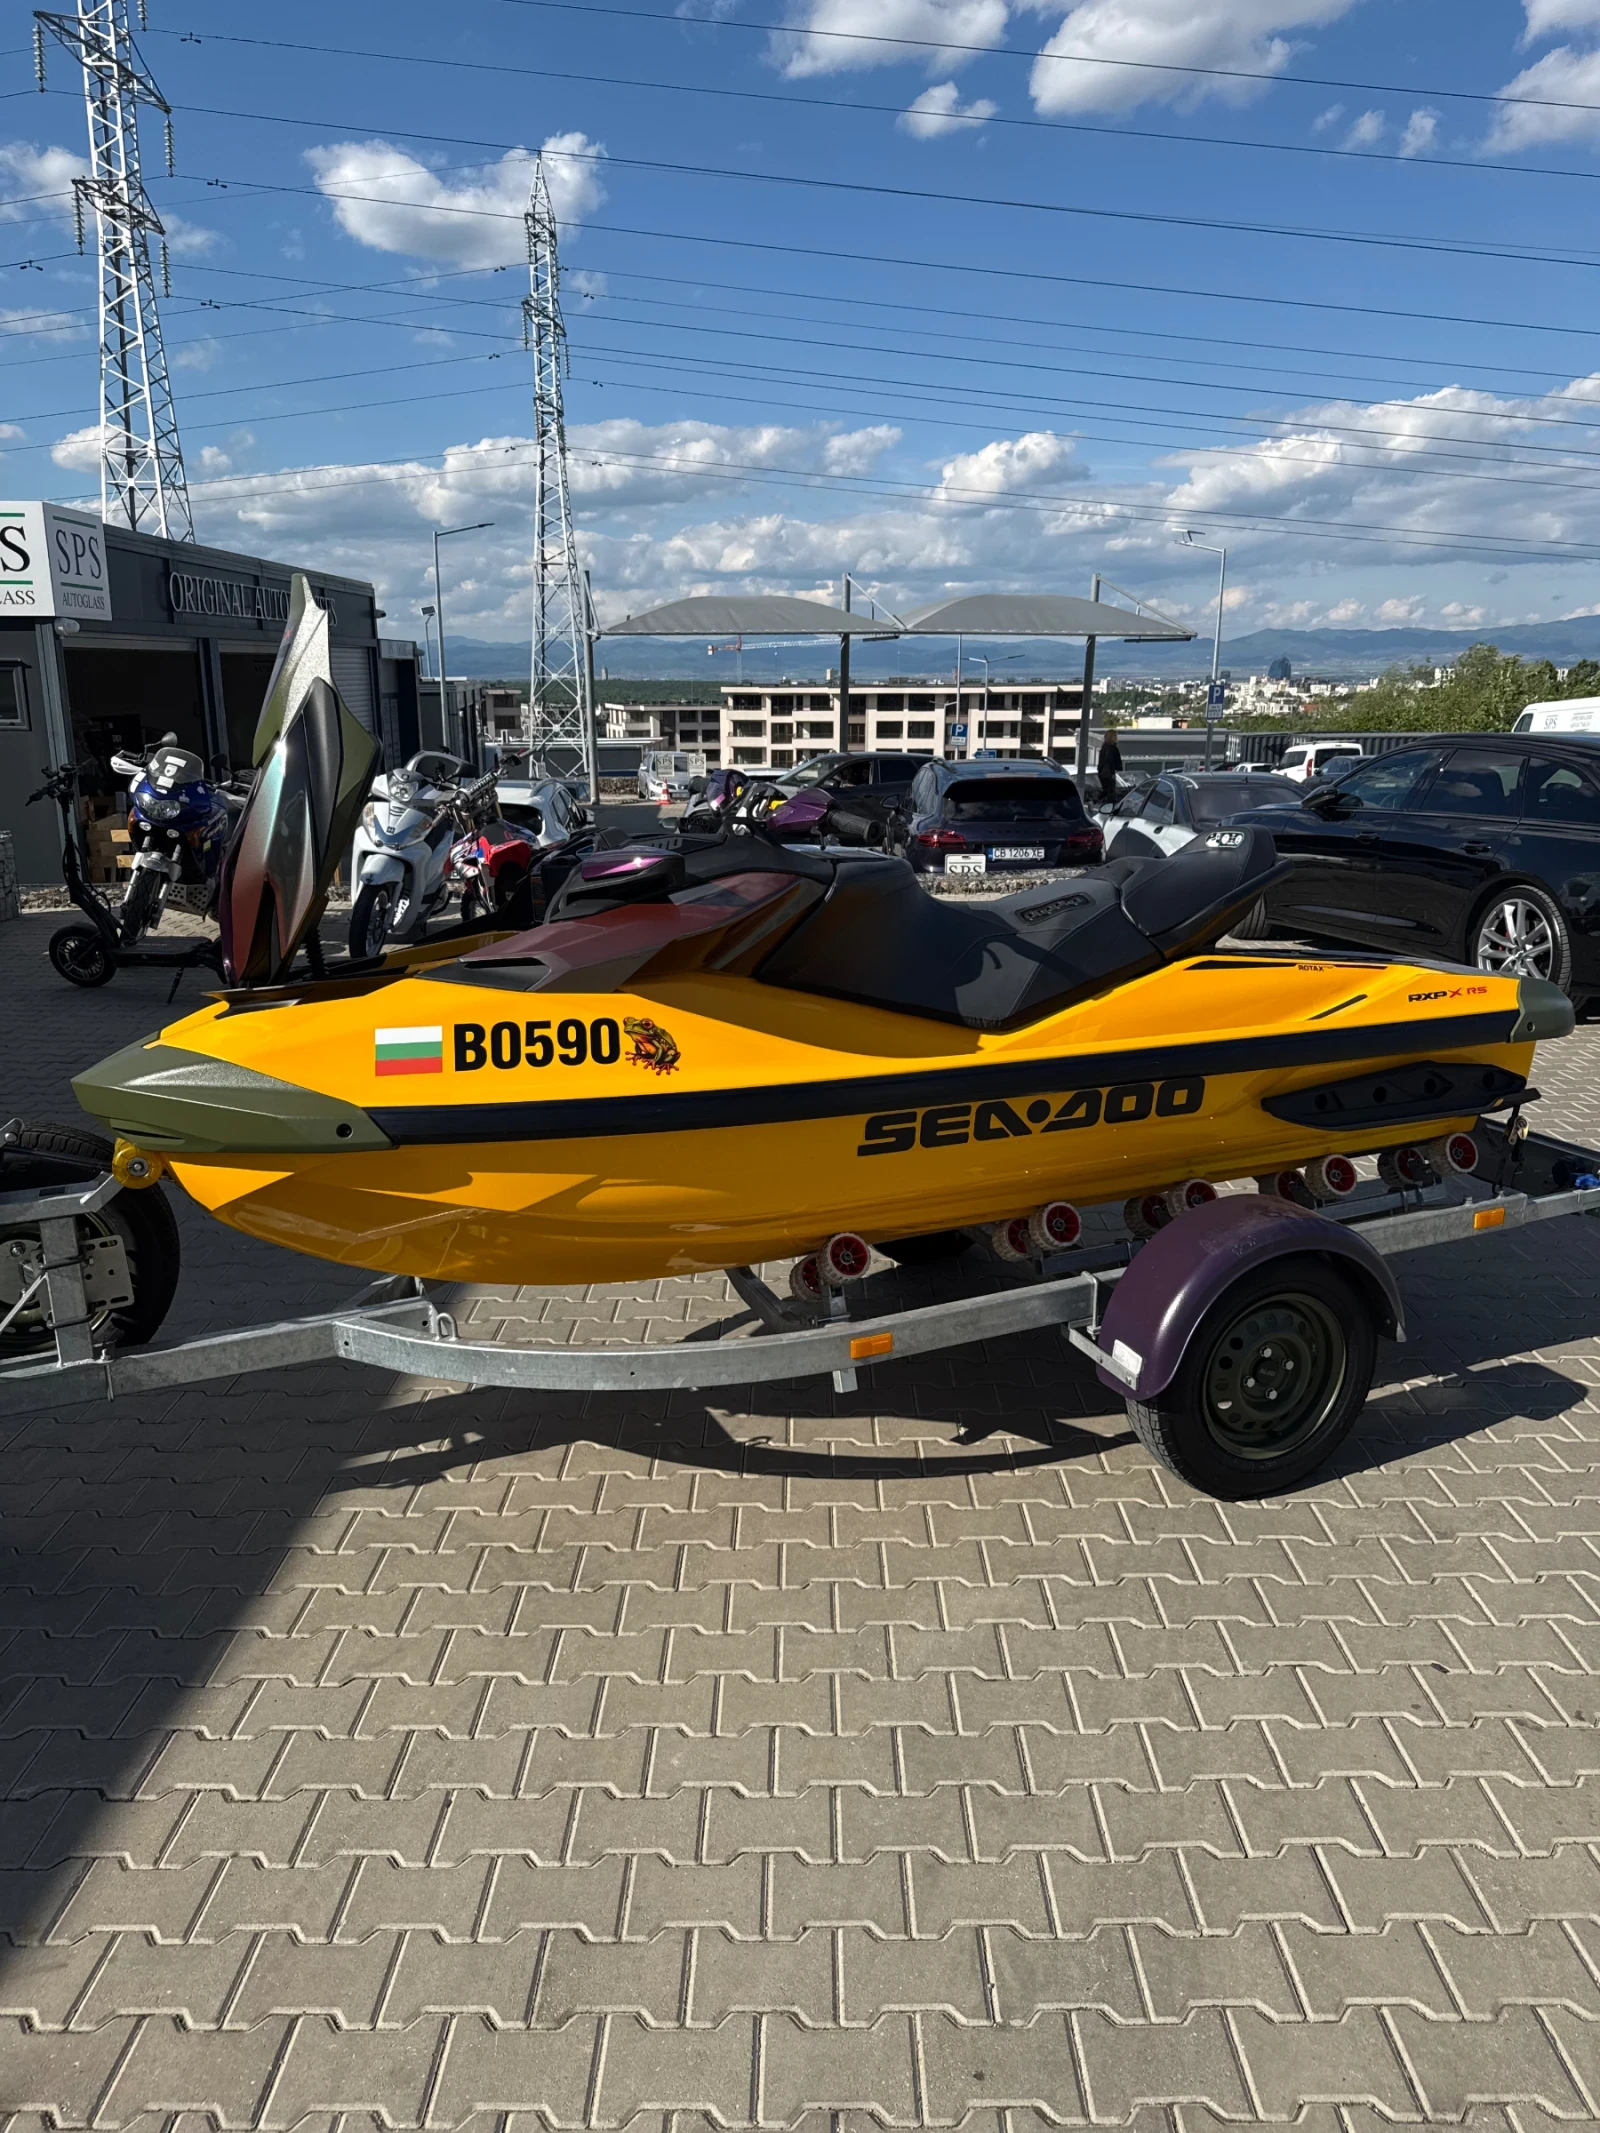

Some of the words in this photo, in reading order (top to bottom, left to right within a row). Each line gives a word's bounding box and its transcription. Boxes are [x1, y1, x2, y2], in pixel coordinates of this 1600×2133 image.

[55, 529, 102, 580] SPS
[0, 590, 36, 606] ASS
[62, 592, 106, 611] AUTOGLASS
[170, 572, 251, 618] ORIGINAL
[1213, 686, 1221, 703] P
[955, 724, 964, 736] P
[1544, 717, 1558, 730] SPS
[689, 757, 705, 765] SPS
[994, 848, 1006, 858] CB
[1009, 848, 1030, 858] 1206
[1298, 964, 1325, 972] ROTAX
[1467, 986, 1487, 995] RS
